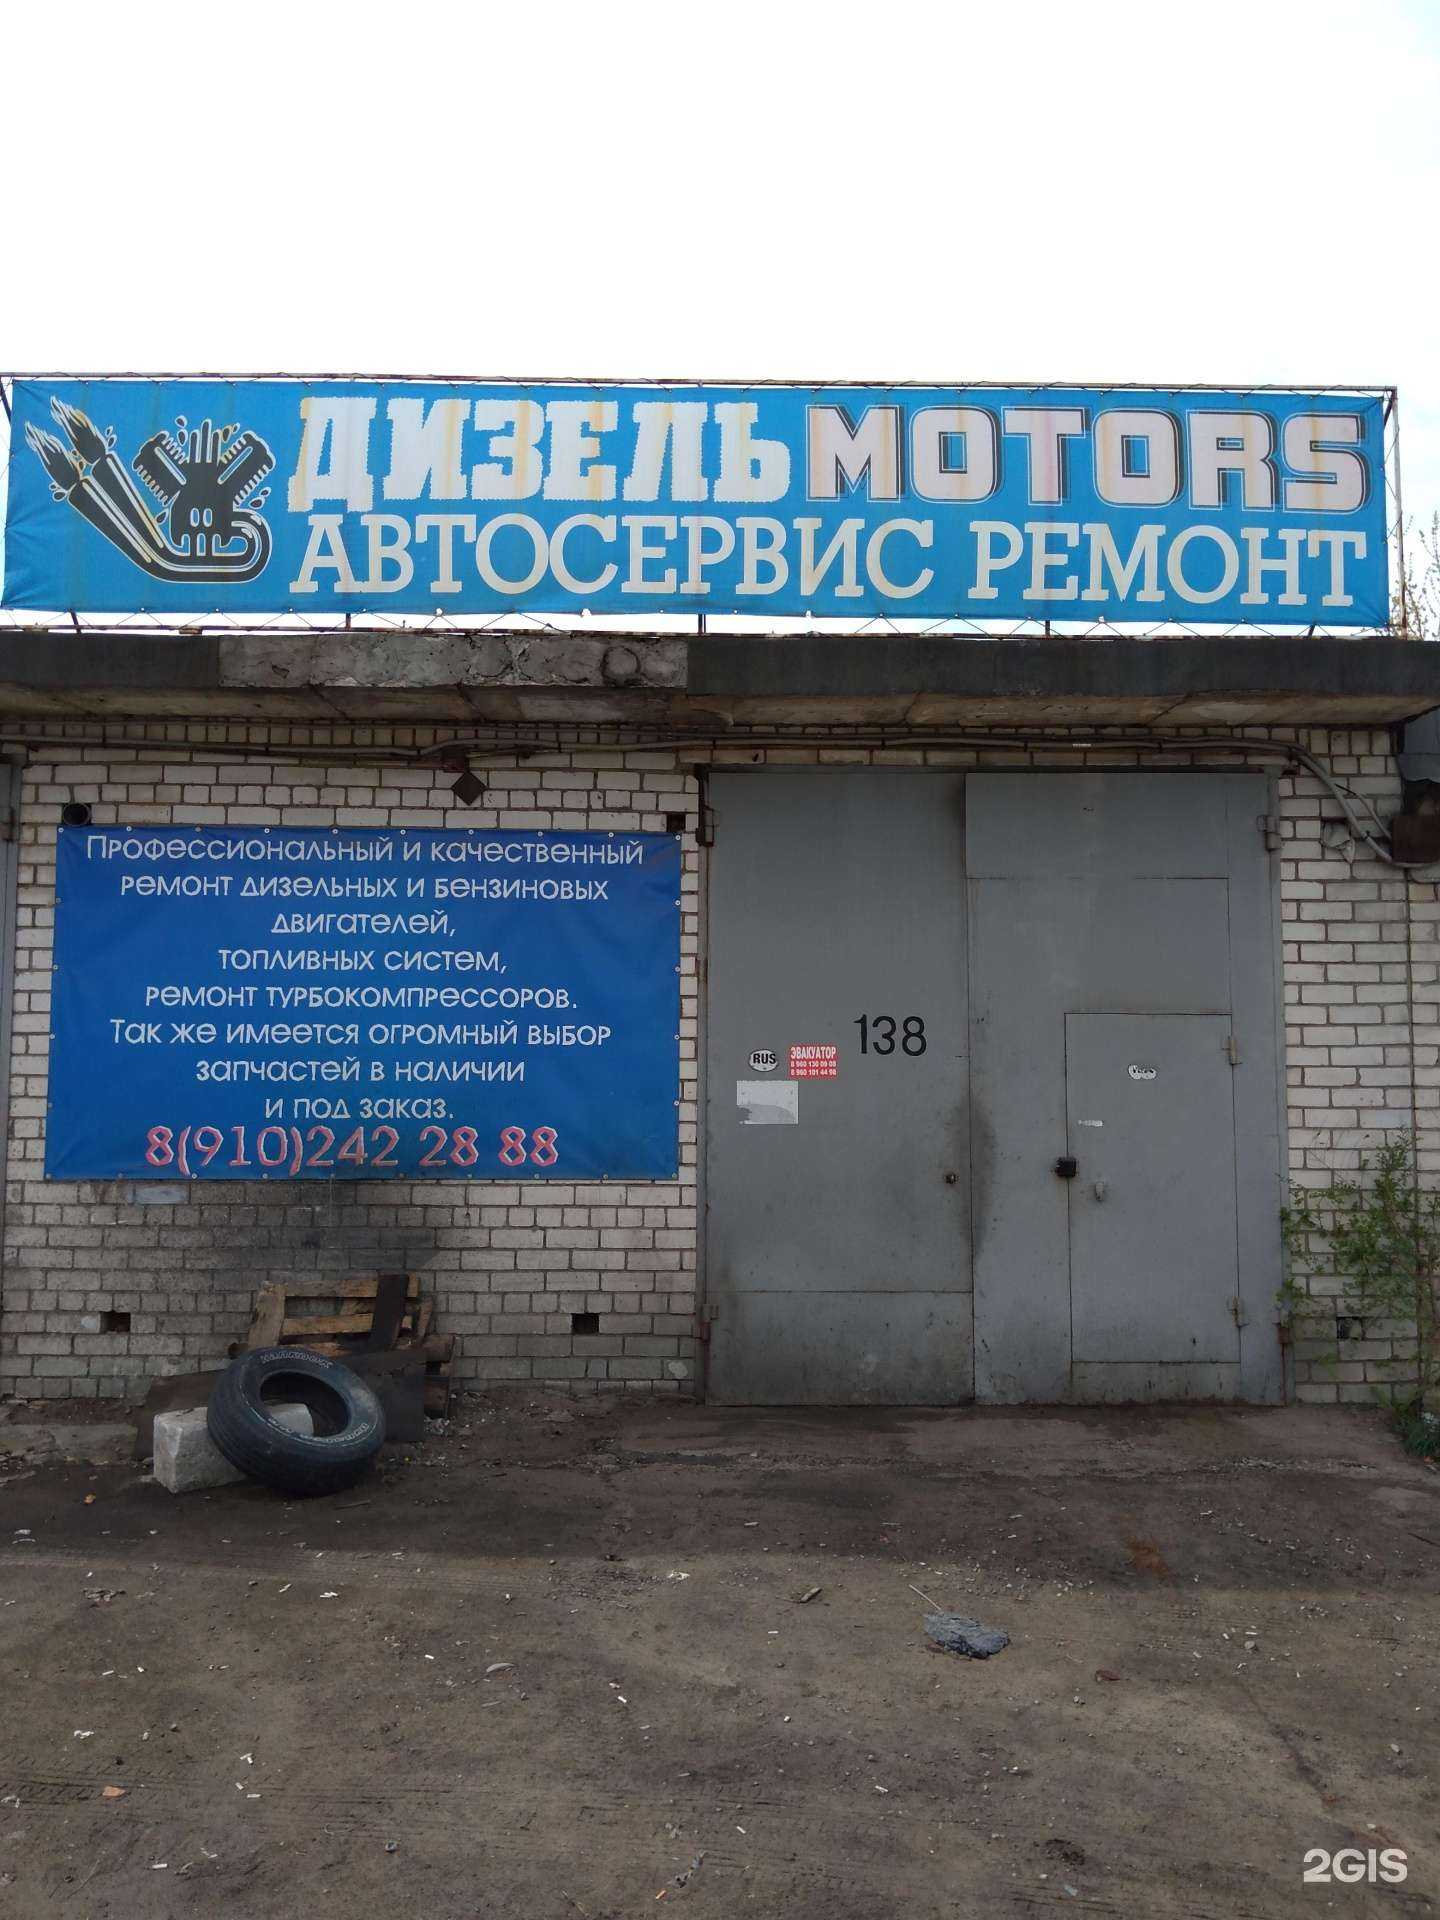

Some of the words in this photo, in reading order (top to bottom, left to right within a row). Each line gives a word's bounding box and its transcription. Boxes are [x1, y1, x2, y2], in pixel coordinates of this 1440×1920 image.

[288, 397, 790, 512] ДИЗЕЛЬ
[805, 404, 1369, 514] MOTORS
[288, 514, 933, 598] АВТОСЕРВИС
[969, 521, 1366, 606] РЕМОНТ
[88, 836, 392, 860] Профессиональный
[404, 842, 420, 860] и
[432, 841, 642, 864] качественный
[122, 876, 233, 896] ремонт
[240, 877, 397, 897] дизельных
[407, 879, 424, 897] и
[435, 879, 608, 899] бензиновых
[271, 910, 455, 936] двигателей,
[219, 950, 374, 970] топливных
[384, 951, 506, 973] систем,
[146, 986, 257, 1006] ремонт
[266, 987, 576, 1008] турбокомпрессоров.
[111, 1020, 161, 1043] Так
[171, 1024, 216, 1043] же
[227, 1024, 358, 1044] имеется
[369, 1020, 517, 1044] огромный
[528, 1025, 610, 1045] выбор
[853, 1014, 927, 1057] 138
[752, 1053, 777, 1065] RUS
[790, 1046, 837, 1060] ЭВАКУАТОР
[197, 1057, 360, 1081] запчастей
[371, 1062, 384, 1080] в
[396, 1062, 524, 1081] наличии
[266, 1099, 283, 1118] и
[294, 1098, 350, 1118] под
[360, 1098, 453, 1118] заказ.
[146, 1126, 399, 1175] 8(910)242
[420, 1126, 478, 1166] 28
[499, 1126, 558, 1166] 88
